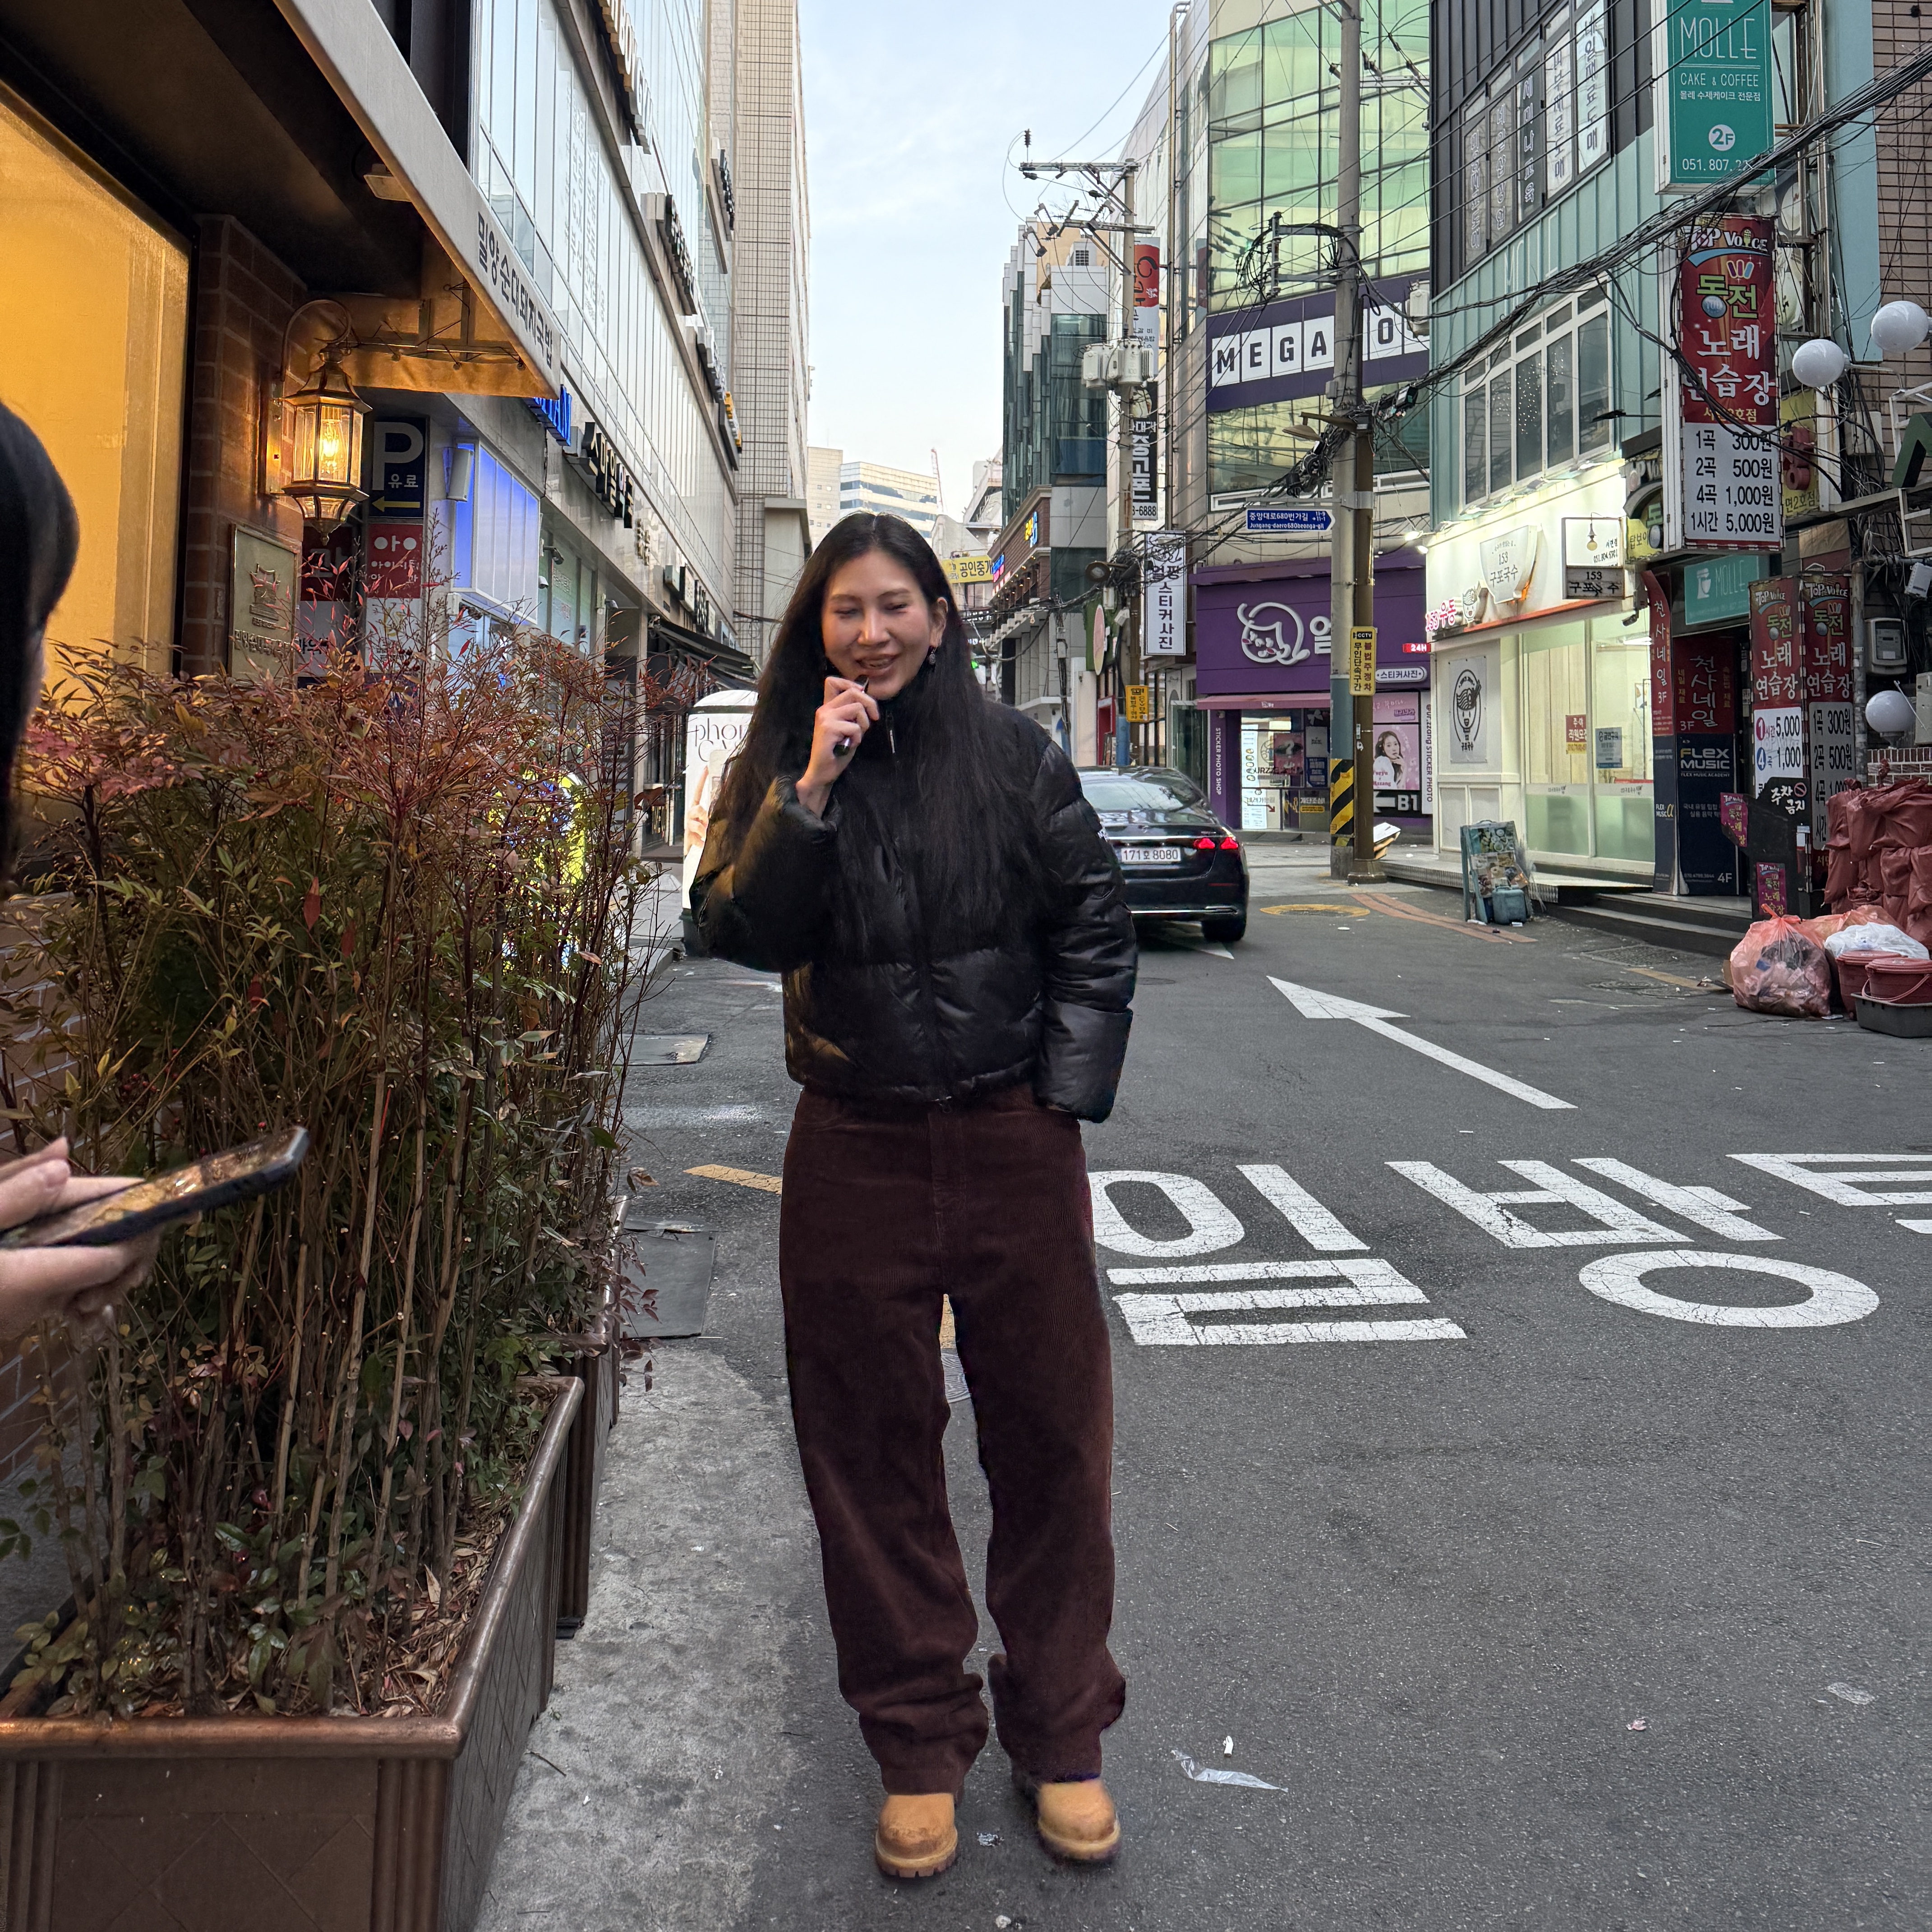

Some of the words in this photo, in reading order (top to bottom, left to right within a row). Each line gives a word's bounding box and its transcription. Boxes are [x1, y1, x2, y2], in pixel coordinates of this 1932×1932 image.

[1681, 17, 1757, 59] MOLLE
[1680, 73, 1706, 86] CAKE
[1712, 77, 1716, 86] &
[1720, 74, 1759, 87] COFFEE
[1697, 91, 1736, 101] 수제케이크
[1738, 92, 1761, 101] 전문점
[1711, 128, 1734, 145] 2F
[478, 211, 553, 370] 밀양순대돼지국밥
[1697, 324, 1759, 360] 노래
[1696, 430, 1716, 451] 1곡
[372, 421, 424, 491] P
[1696, 457, 1716, 478] 2곡
[1733, 458, 1773, 479] 500원
[388, 474, 419, 488] 유료
[1696, 485, 1717, 505] 4곡
[1725, 485, 1774, 507] 1,000원
[1784, 491, 1816, 514] 면2호점
[1249, 512, 1309, 522] 중앙대로680번가길
[1691, 512, 1718, 534] 1시간
[1726, 512, 1775, 535] 5,000원
[1499, 551, 1508, 565] 153
[1490, 564, 1518, 588] 구포국수
[1586, 571, 1602, 580] 153
[1715, 559, 1746, 598] MOLLE
[1158, 582, 1175, 649] 스티커사진
[1411, 643, 1427, 652] 24H
[1761, 641, 1792, 669] 노래
[1812, 641, 1846, 667] 노래
[1353, 642, 1362, 692] 무인단속구간
[1380, 669, 1418, 679] 스티커사진
[1690, 655, 1718, 727] 천사네일
[1756, 671, 1798, 700] 연습장
[1806, 669, 1853, 699] 연습장
[1658, 691, 1667, 704] 3F
[1680, 721, 1694, 731] 3F
[1775, 715, 1800, 740] 5,000
[1813, 709, 1823, 736] 1곡
[1827, 708, 1851, 736] 300원
[1680, 759, 1730, 769] MUSIC
[1777, 746, 1801, 770] 1,000
[1814, 744, 1824, 771] 2곡
[1829, 743, 1852, 771] 500원
[1397, 794, 1418, 811] B1
[1771, 785, 1793, 805] 주차
[1815, 779, 1826, 806] 4곡
[1785, 798, 1805, 815] 금지
[1153, 849, 1179, 860] 8080
[1717, 873, 1733, 883] 4F
[1765, 892, 1780, 902] 노래
[1091, 1153, 1932, 1345] 일방
